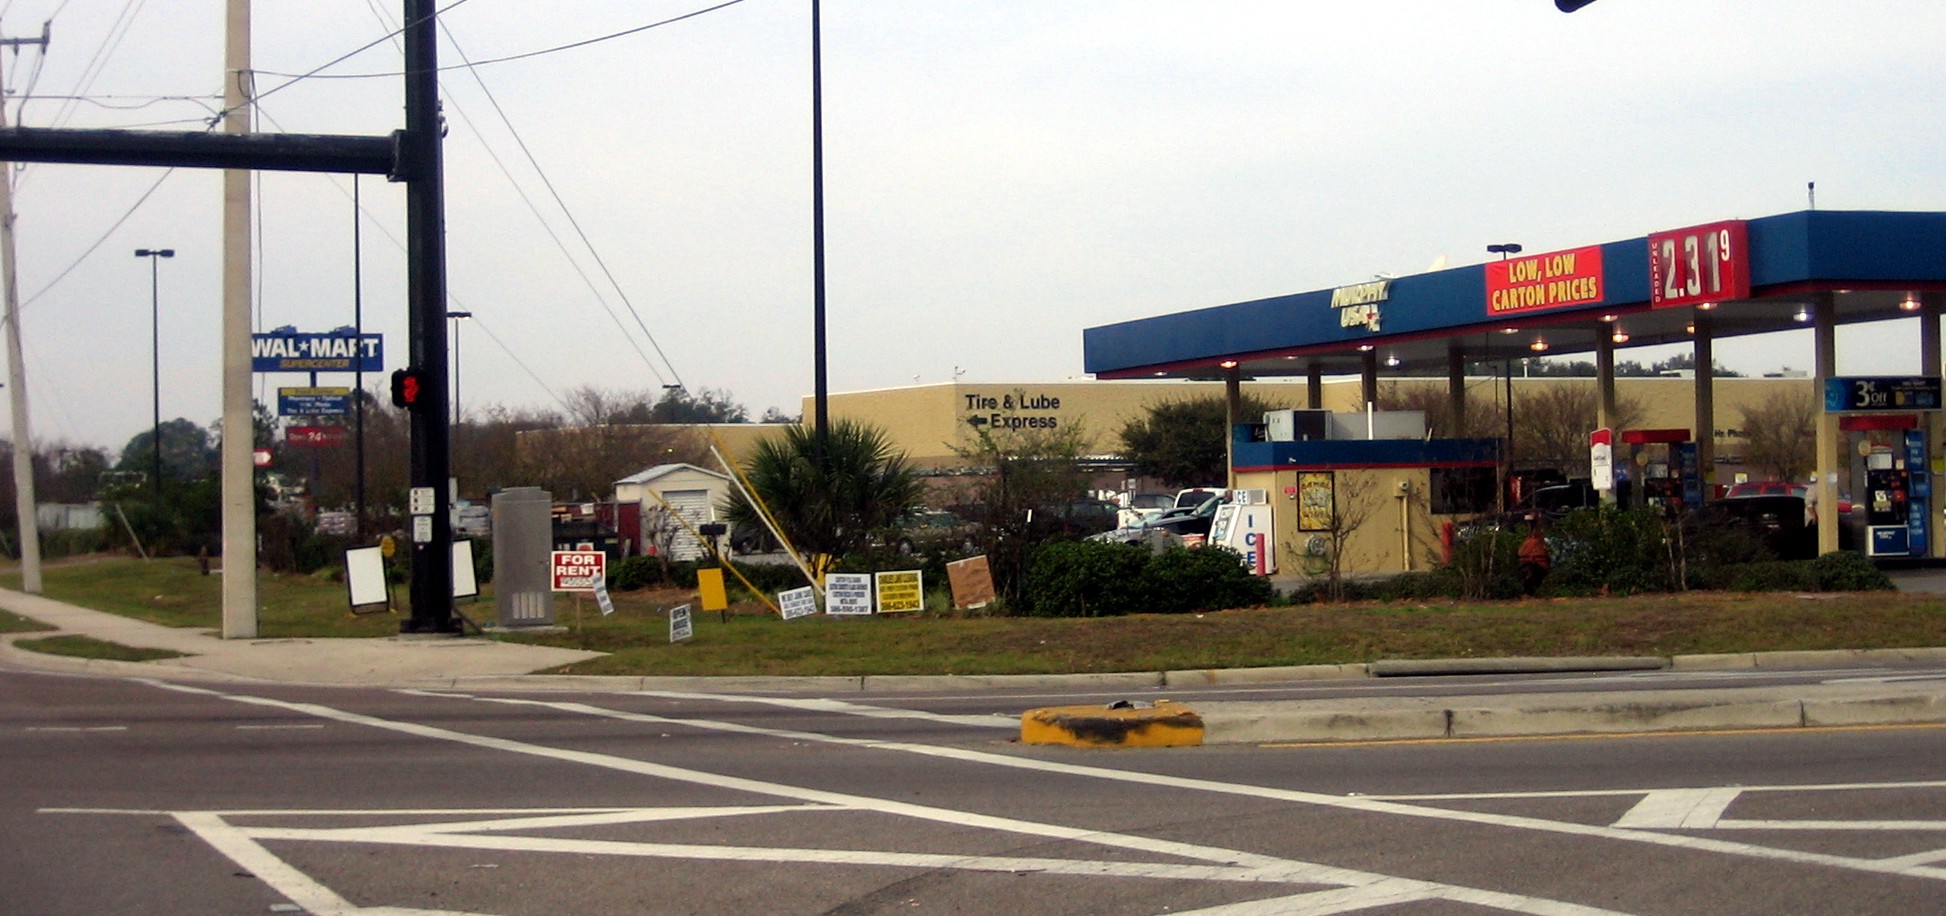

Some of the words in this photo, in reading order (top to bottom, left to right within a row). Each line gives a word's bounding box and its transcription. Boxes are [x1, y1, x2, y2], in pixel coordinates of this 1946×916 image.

[1509, 258, 1542, 284] LOW,
[1545, 253, 1576, 278] LOW
[1651, 242, 1661, 303] UNLEADED
[1491, 284, 1546, 312] CARTON
[1549, 276, 1598, 303] PRICES
[965, 394, 998, 409] Tire
[1003, 394, 1013, 410] &
[1020, 394, 1060, 409] Lube
[991, 413, 1058, 432] Express
[561, 555, 596, 565] FOR
[556, 566, 601, 576] RENT
